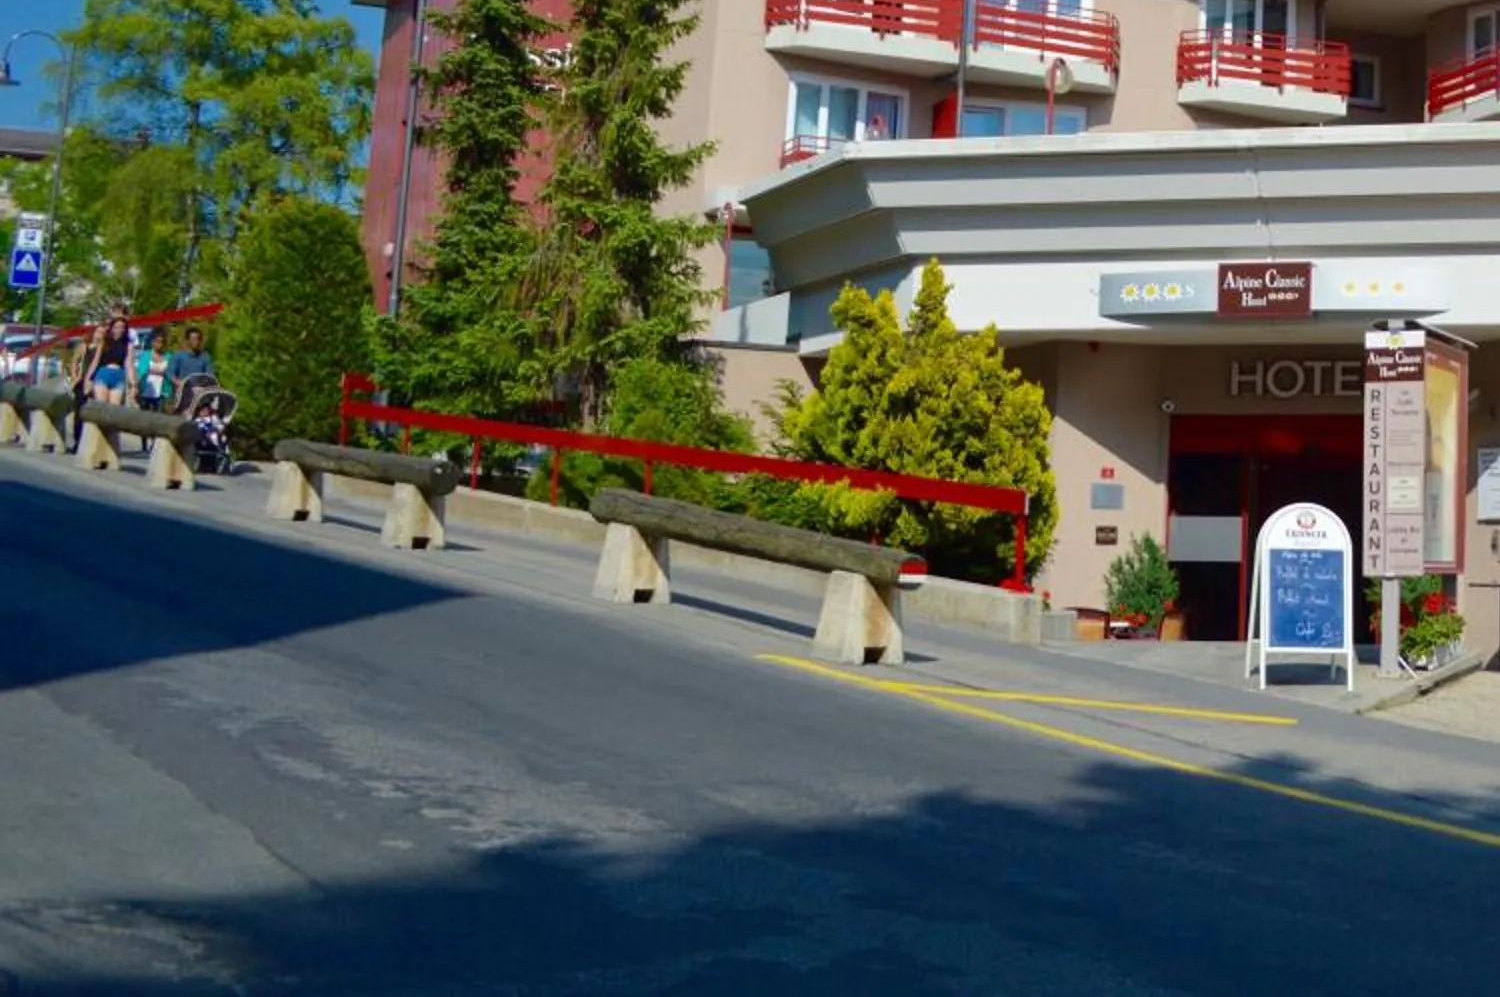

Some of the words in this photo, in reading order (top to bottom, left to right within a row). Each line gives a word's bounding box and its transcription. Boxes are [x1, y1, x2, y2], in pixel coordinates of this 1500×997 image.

[1223, 270, 1263, 291] Alpine
[1265, 269, 1305, 288] Classic
[1231, 360, 1362, 398] HOTE
[1369, 389, 1381, 569] RESTAURANT
